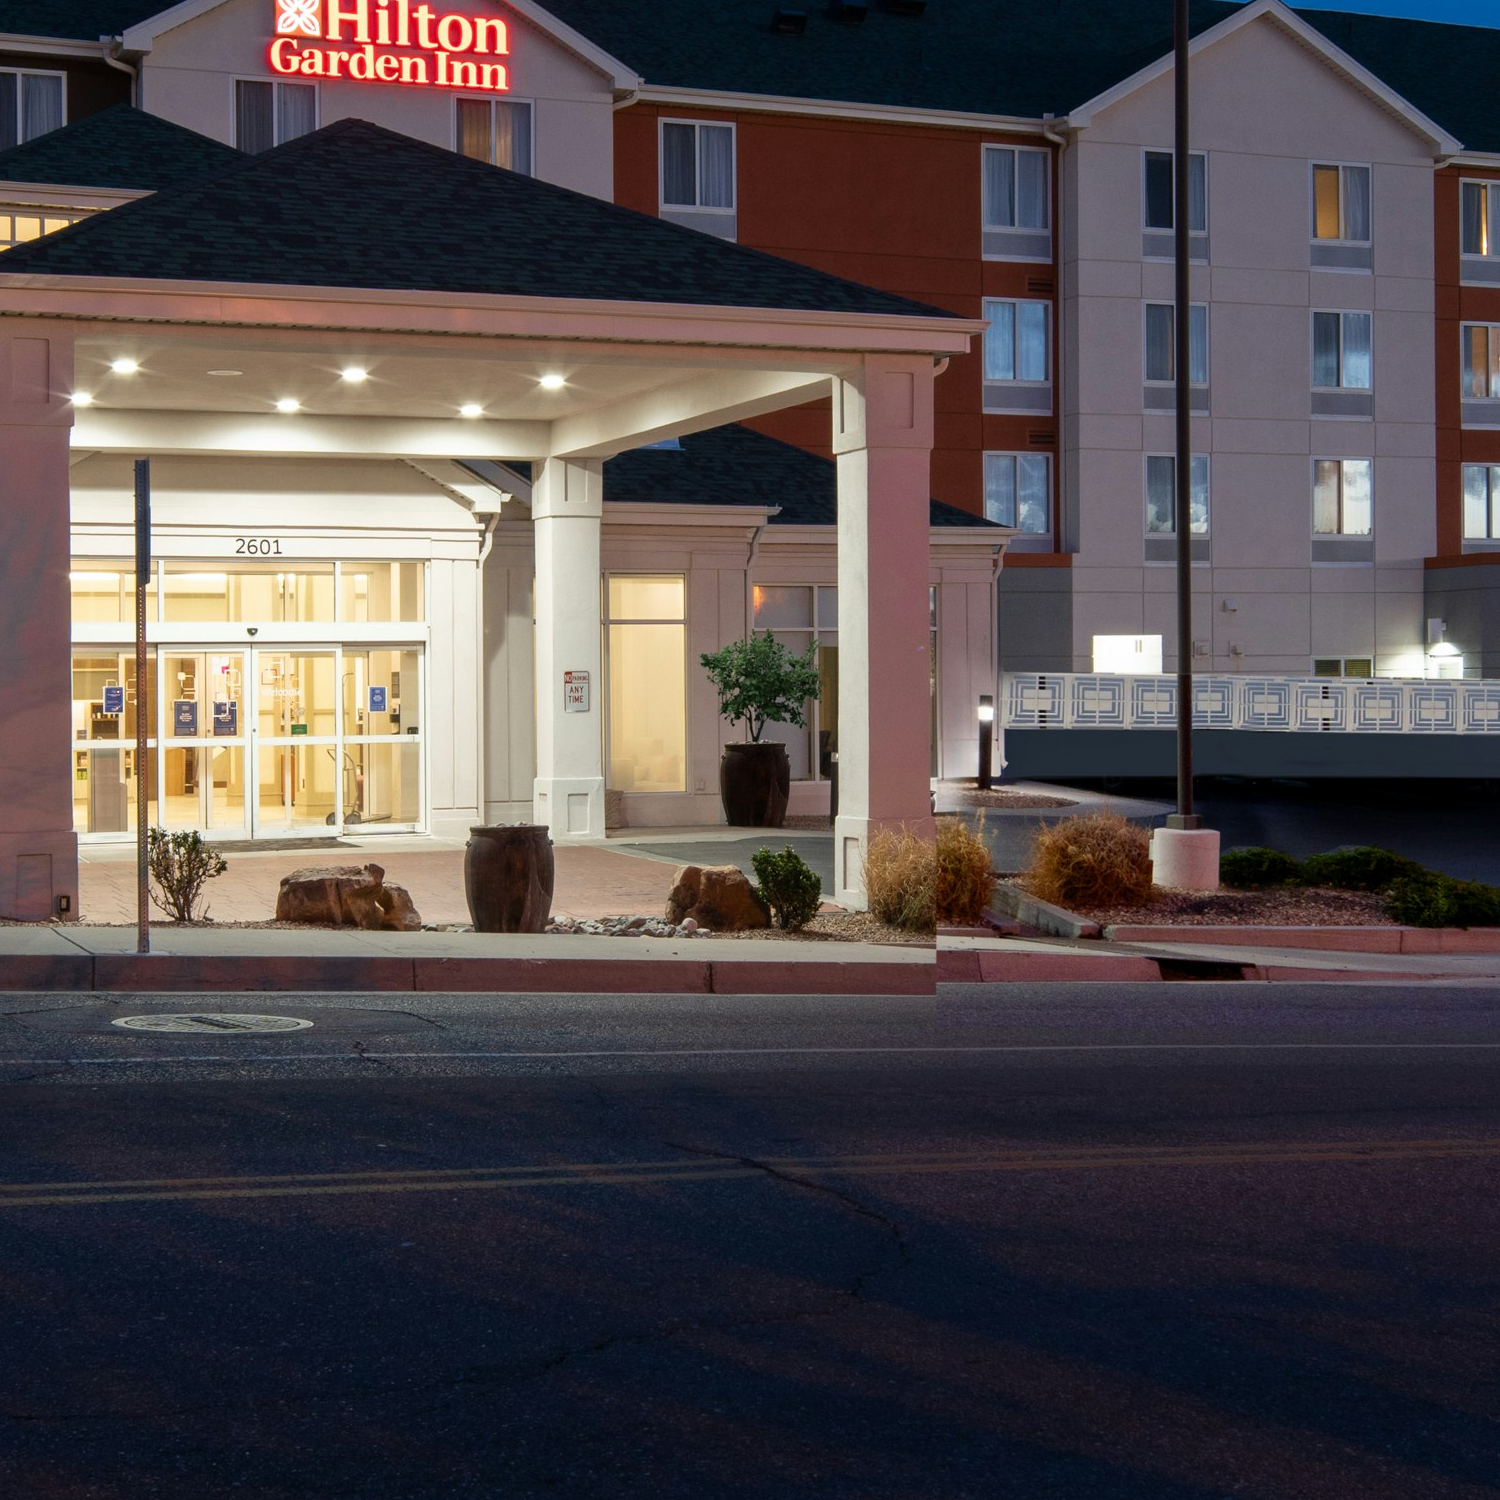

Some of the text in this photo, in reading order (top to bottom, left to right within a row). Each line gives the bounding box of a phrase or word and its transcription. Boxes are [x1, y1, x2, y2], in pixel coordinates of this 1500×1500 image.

[270, 37, 509, 90] Garden Inn
[235, 538, 282, 555] 2601
[569, 686, 584, 694] ANY
[568, 695, 584, 703] TIME
